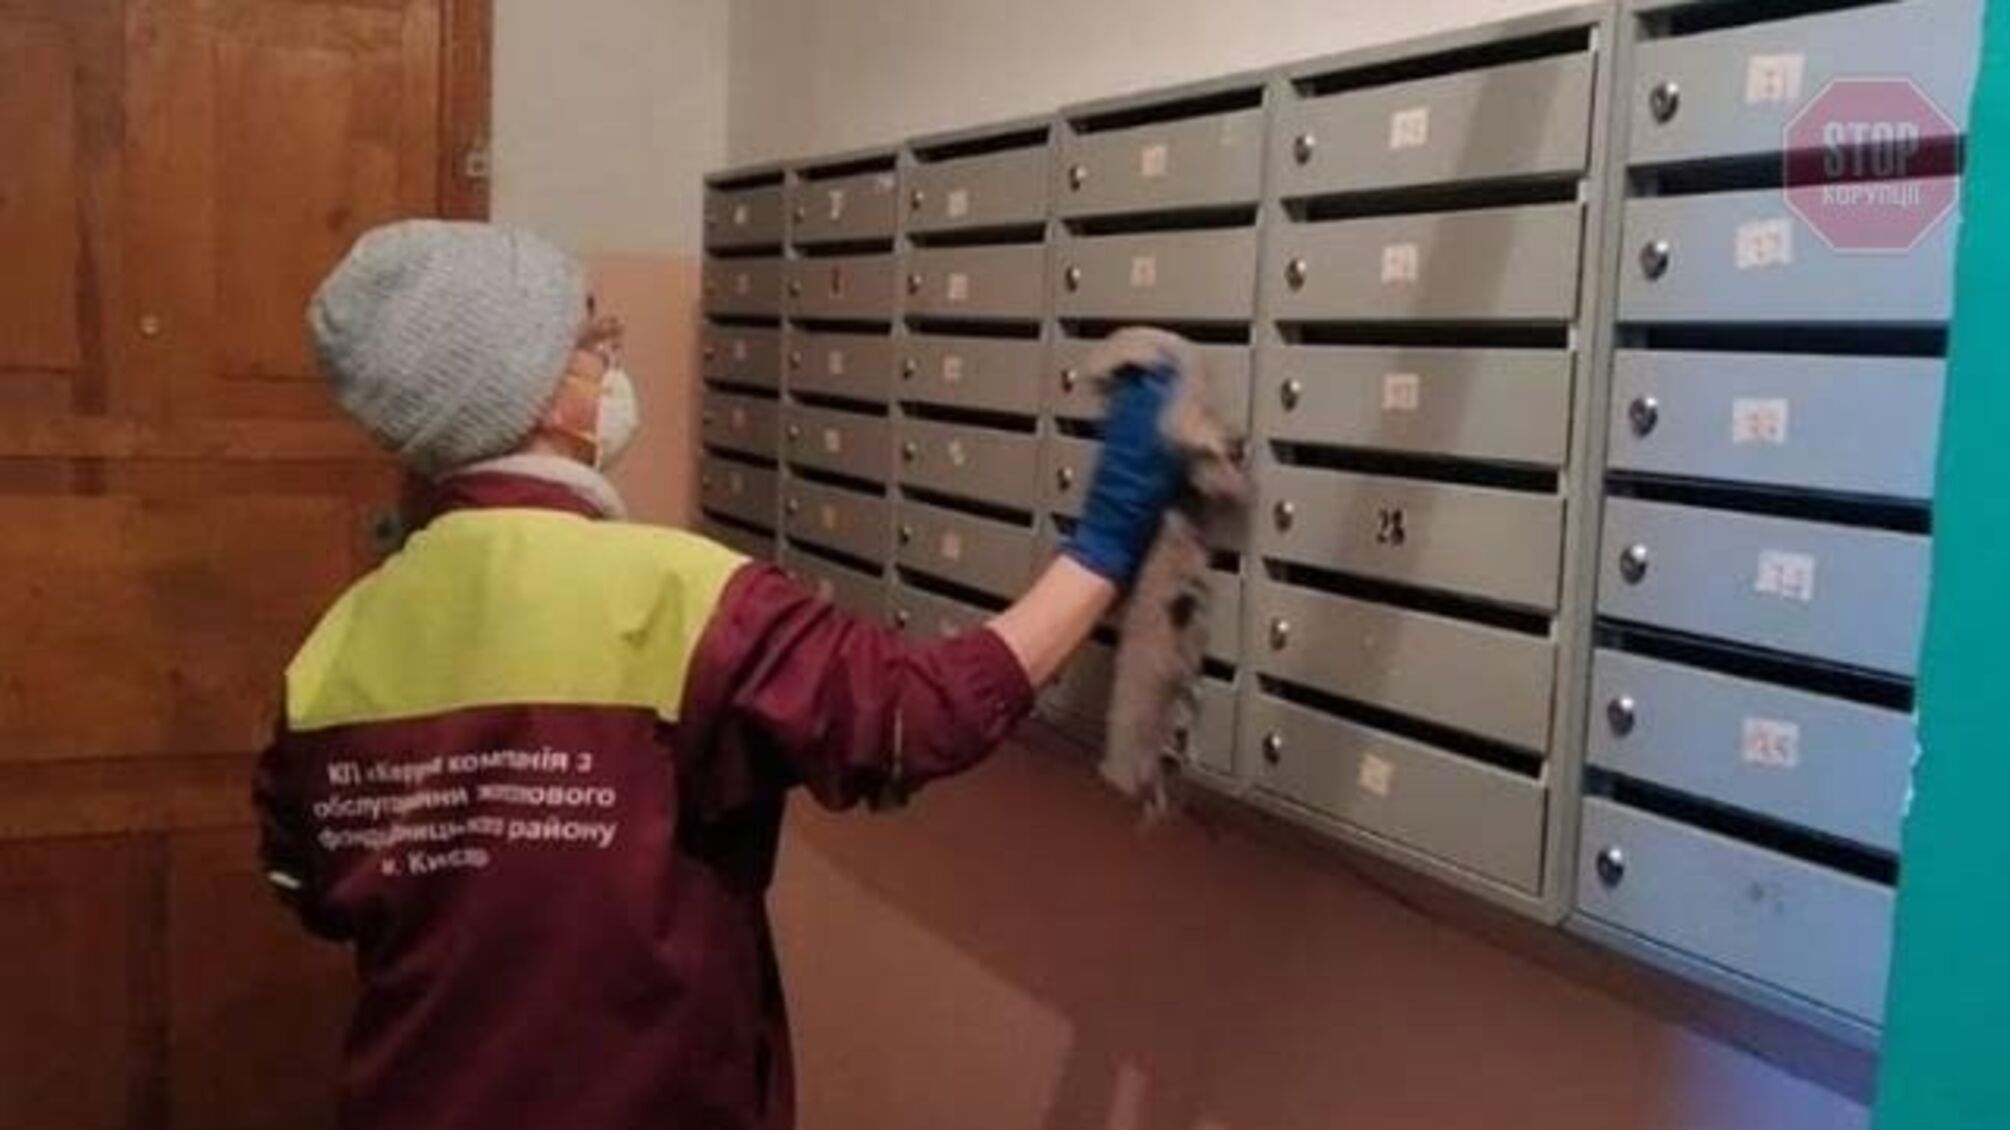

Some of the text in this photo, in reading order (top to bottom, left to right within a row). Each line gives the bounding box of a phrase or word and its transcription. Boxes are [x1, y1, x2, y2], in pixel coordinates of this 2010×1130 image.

[1375, 508, 1406, 547] 28
[576, 752, 593, 773] з
[507, 817, 617, 848] району
